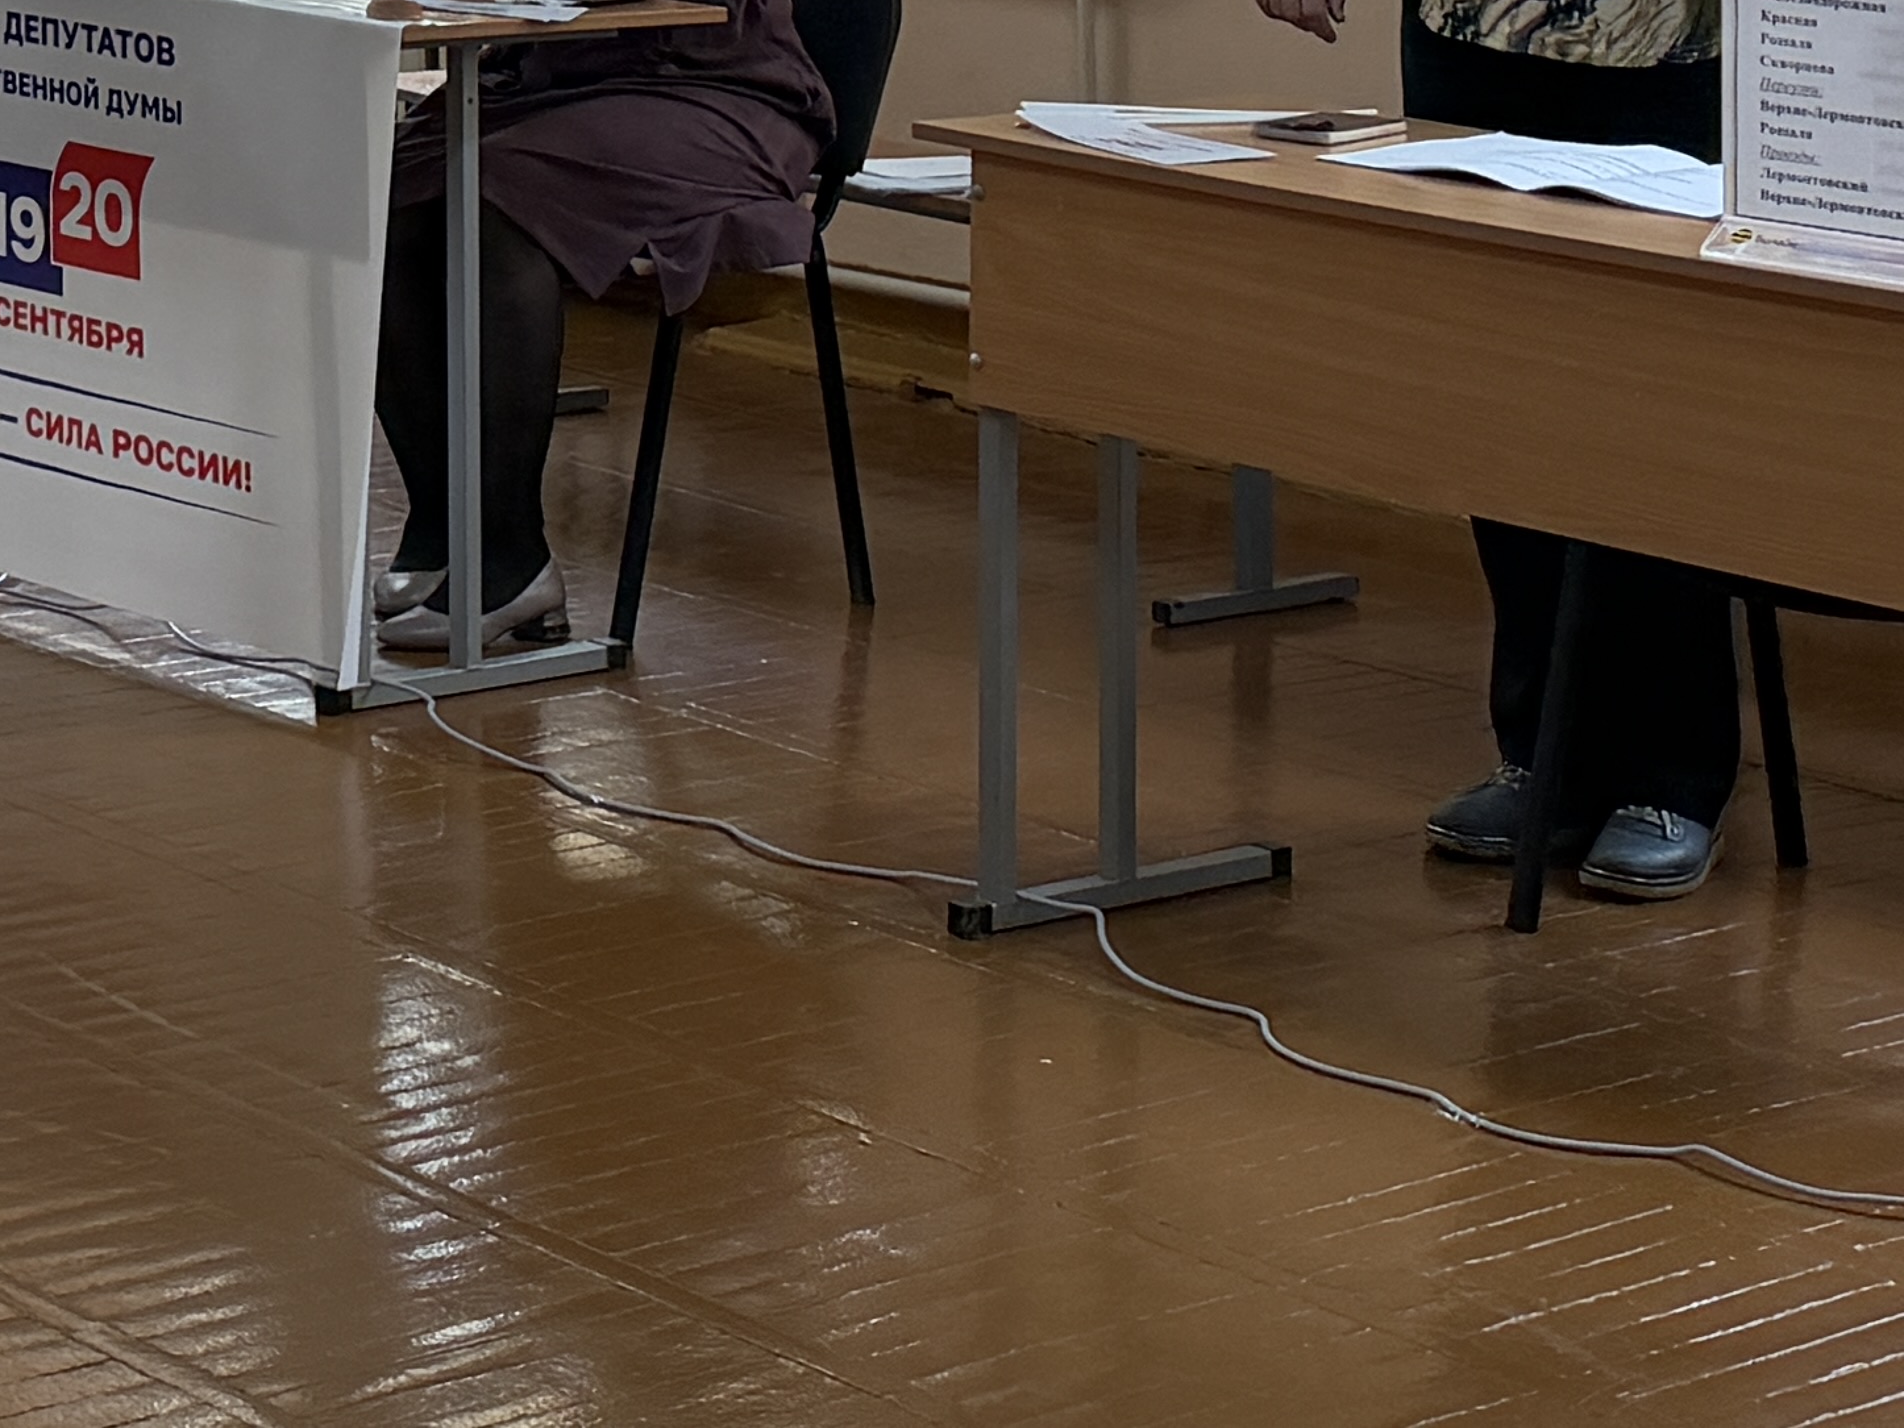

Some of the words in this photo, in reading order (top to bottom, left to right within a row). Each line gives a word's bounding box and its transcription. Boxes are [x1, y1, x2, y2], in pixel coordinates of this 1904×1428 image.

[1760, 9, 1818, 28] Красная
[3, 11, 176, 67] ДЕПУТАТОВ
[105, 88, 183, 126] ДУМЫ
[1760, 100, 1904, 130] Верхне-Лермонтовск
[59, 171, 133, 248] 20
[1760, 189, 1904, 221] Верхне-Лермонтовск
[25, 406, 104, 456] СИЛА
[111, 428, 253, 493] РОССИИ!
